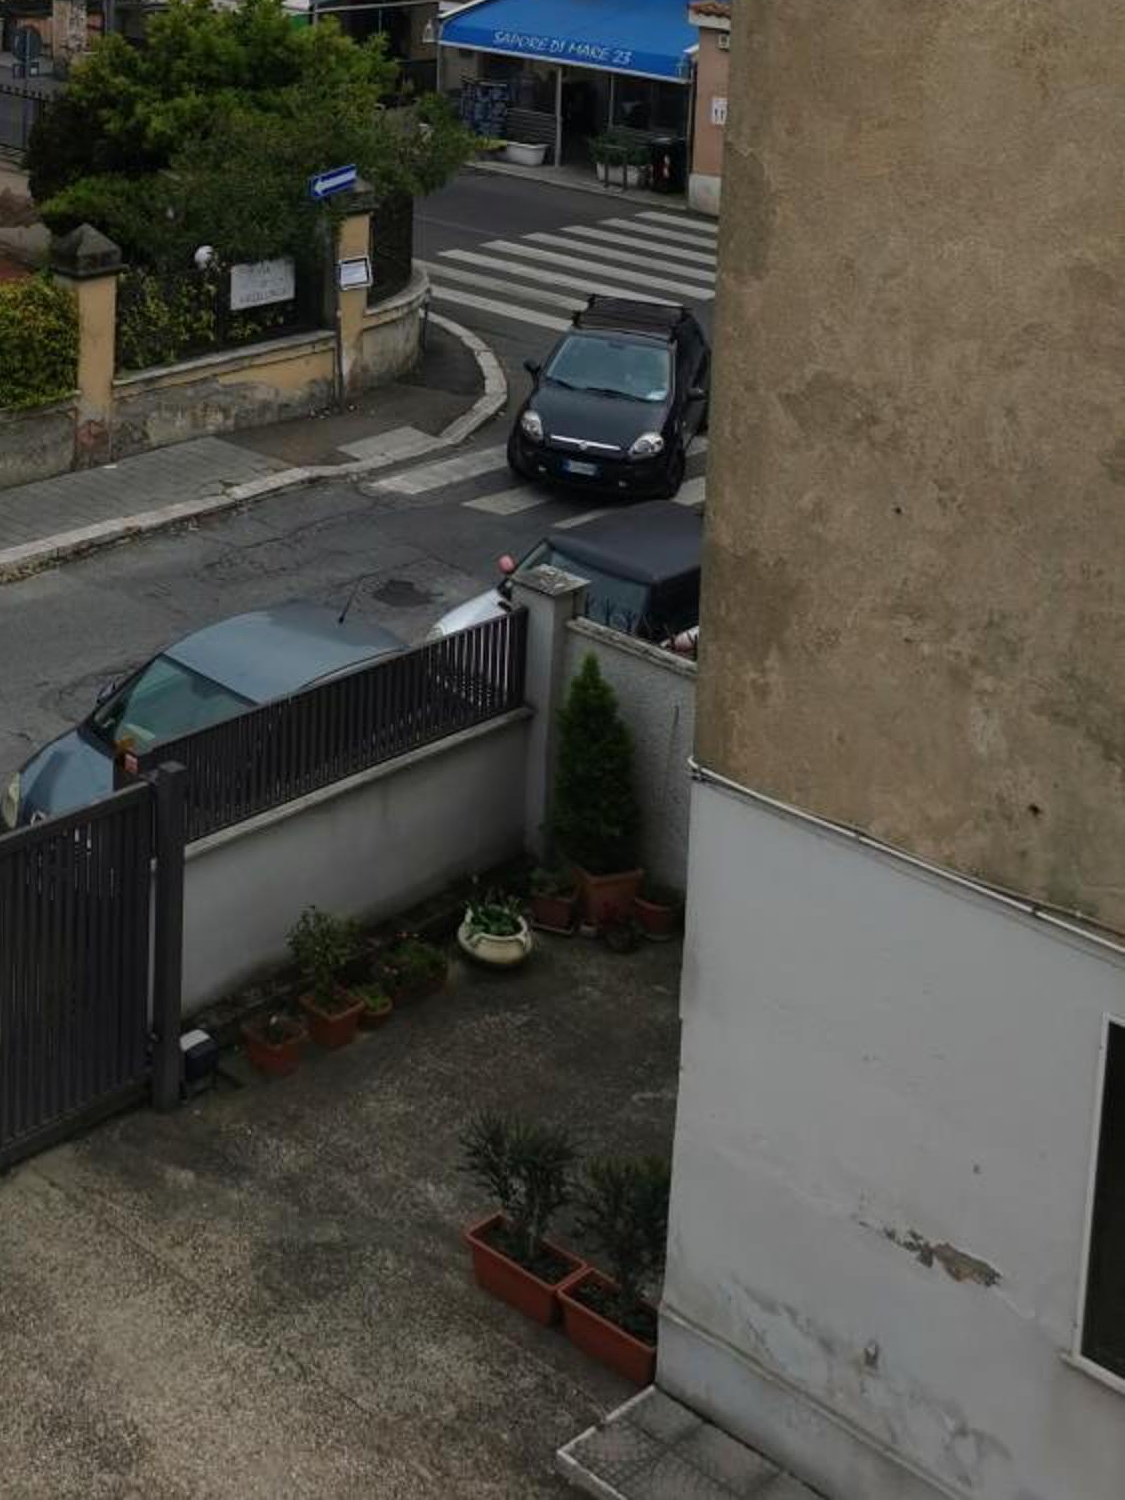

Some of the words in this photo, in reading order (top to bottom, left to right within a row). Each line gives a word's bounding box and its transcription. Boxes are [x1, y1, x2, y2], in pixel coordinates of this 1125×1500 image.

[494, 30, 549, 51] SAPORE
[550, 39, 565, 53] DI
[568, 41, 610, 61] MARE
[613, 49, 633, 65] 23
